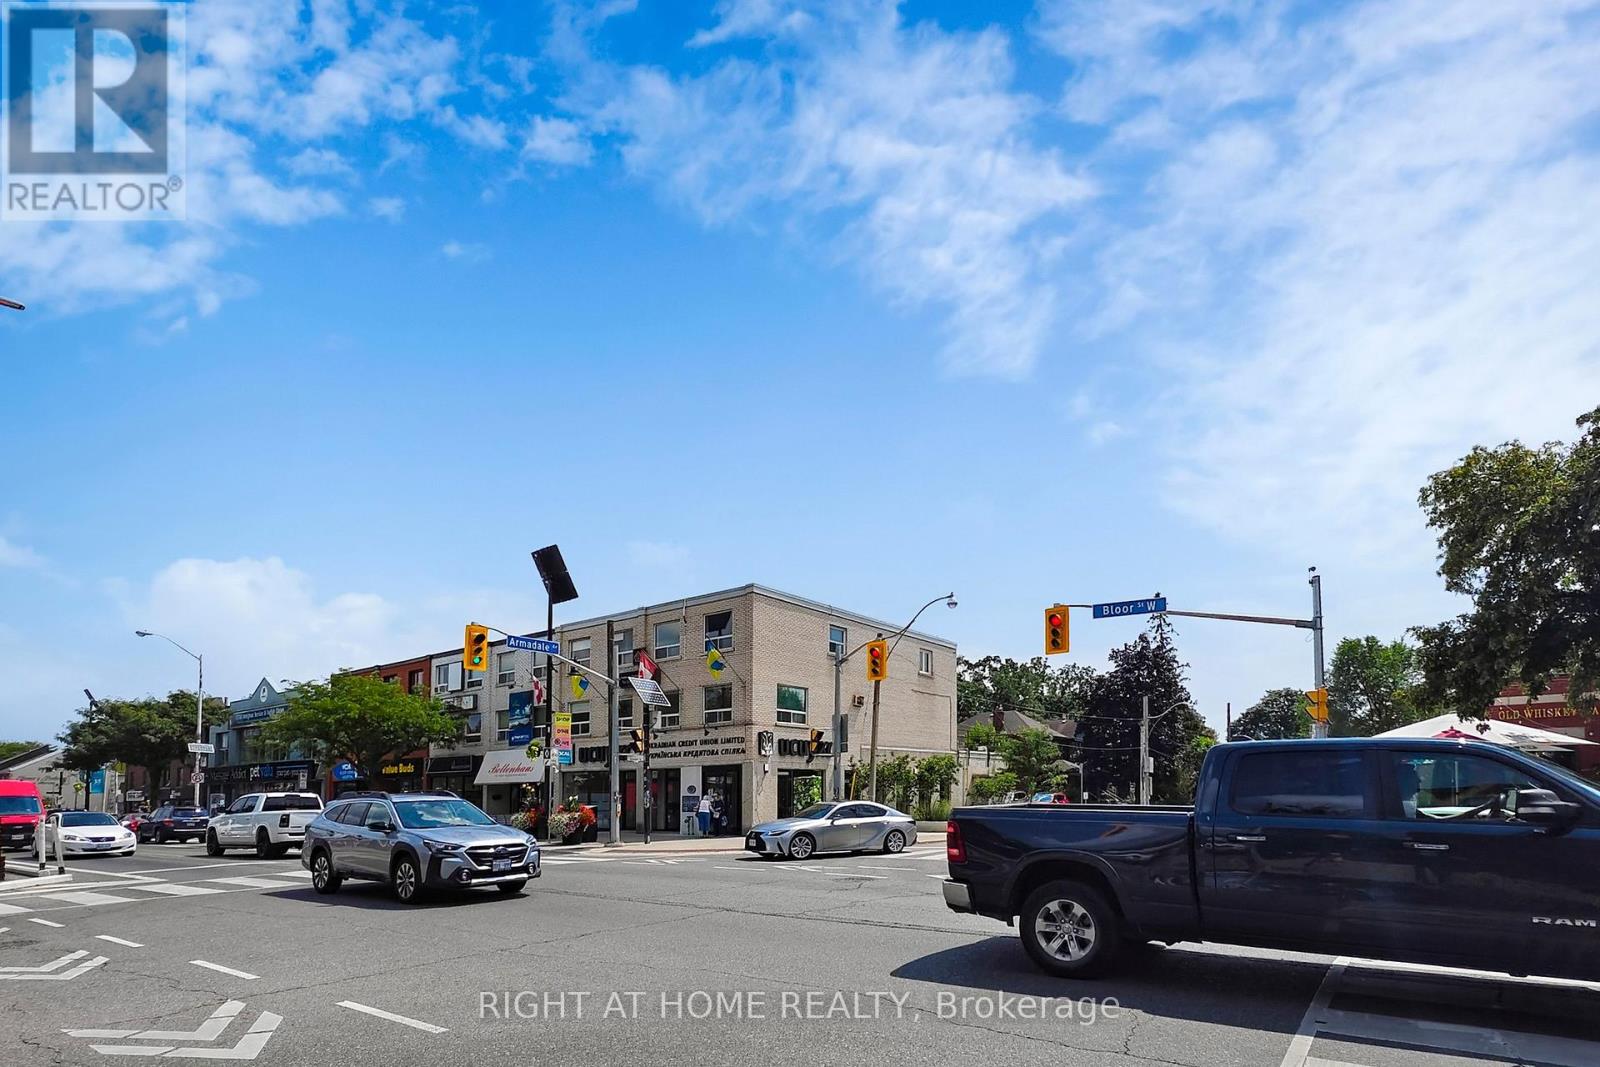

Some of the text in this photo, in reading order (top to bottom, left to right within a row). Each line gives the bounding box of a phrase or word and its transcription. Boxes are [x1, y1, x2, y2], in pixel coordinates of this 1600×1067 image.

[1103, 605, 1133, 615] Bloor
[1146, 600, 1156, 611] W
[509, 637, 550, 651] Armadale
[1498, 709, 1520, 720] OLD
[700, 738, 719, 746] UNION
[720, 736, 745, 745] LIMITED
[1532, 916, 1596, 927] RAM
